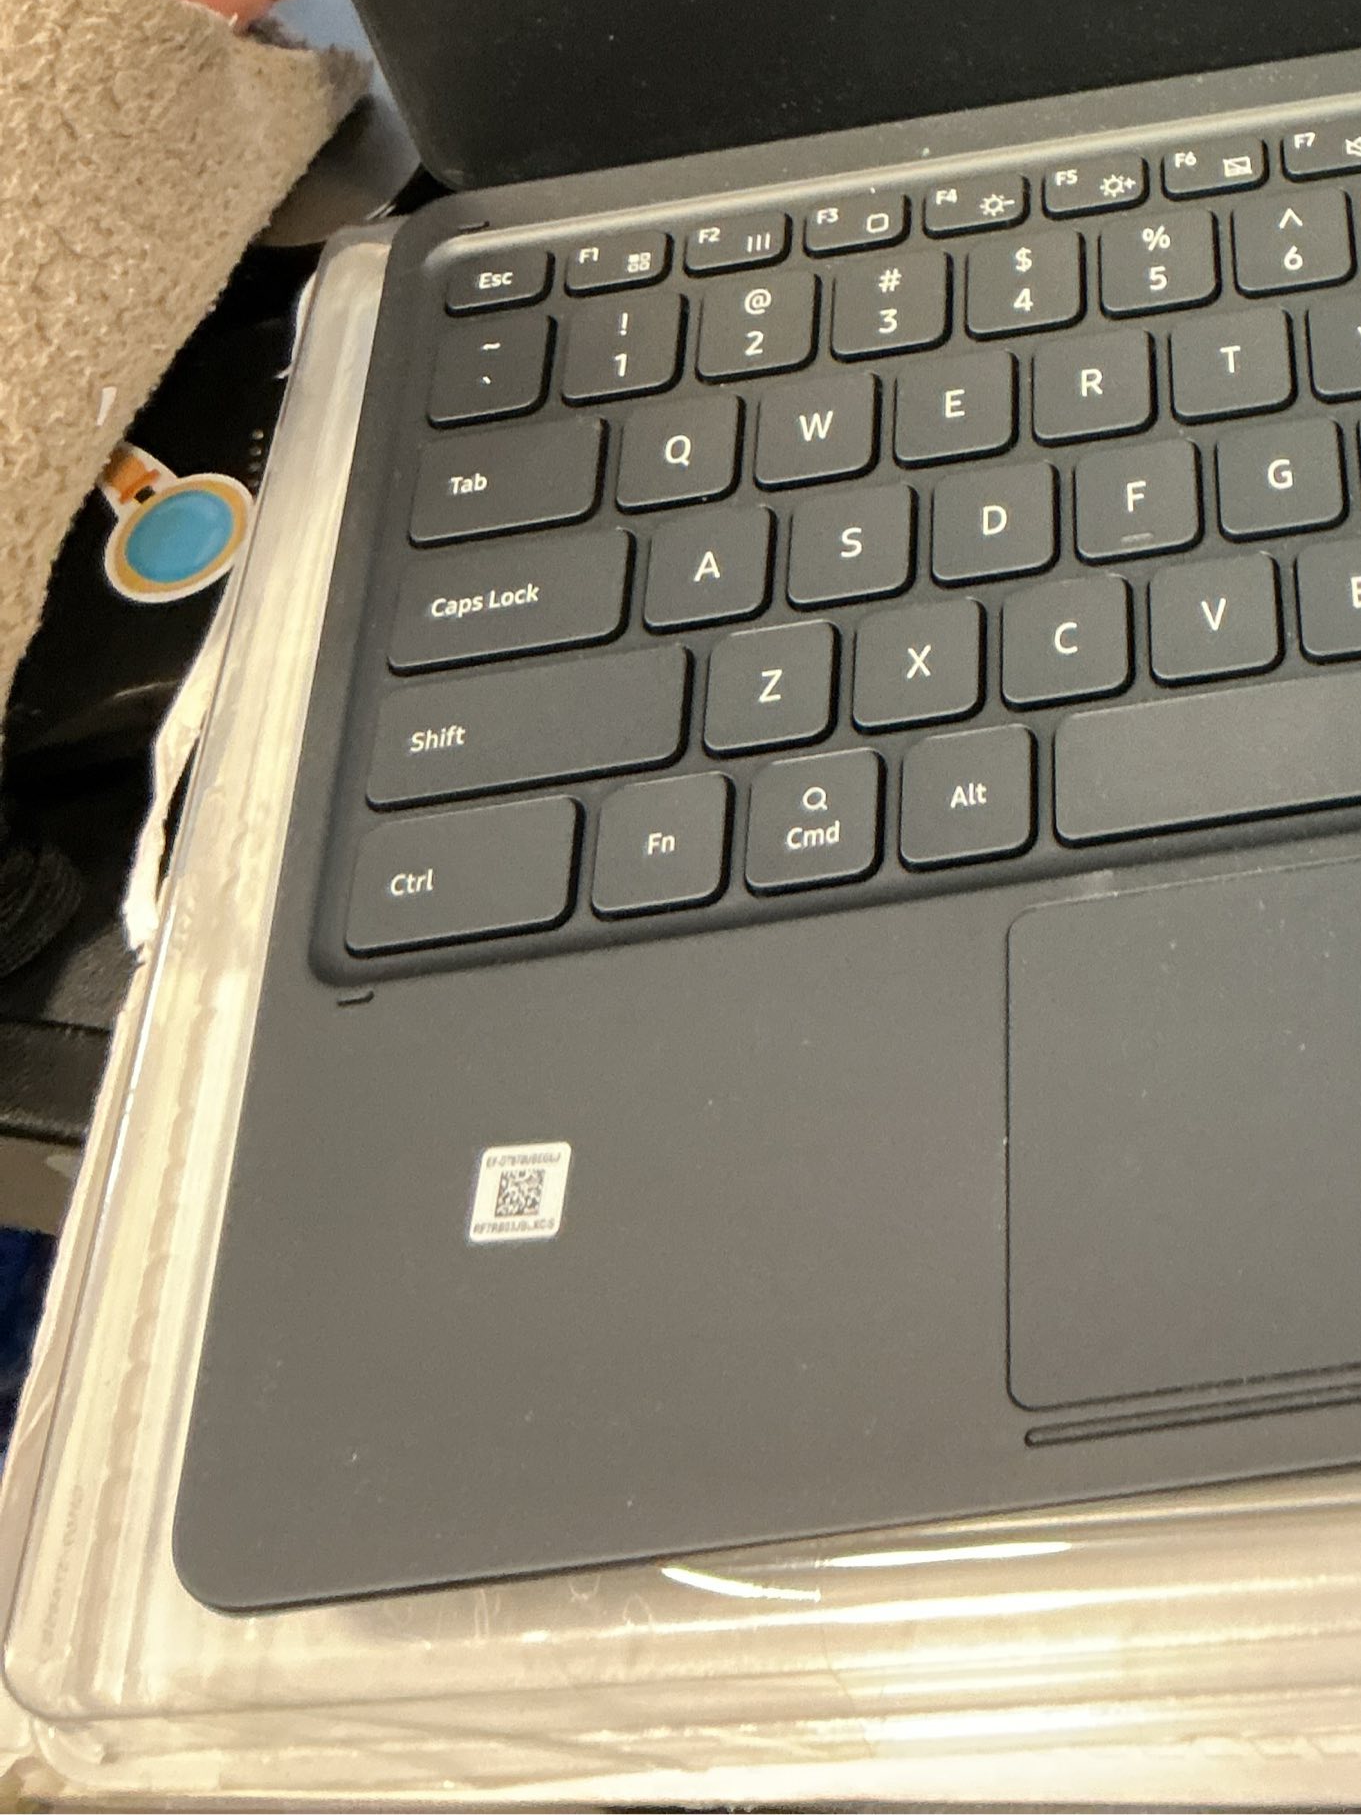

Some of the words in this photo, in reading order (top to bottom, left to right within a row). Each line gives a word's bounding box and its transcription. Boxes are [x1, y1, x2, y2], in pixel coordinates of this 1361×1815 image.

[1293, 131, 1316, 150] F7
[1174, 151, 1197, 169] F6
[1054, 169, 1078, 187] F5
[935, 188, 958, 206] F4
[816, 207, 839, 225] F3
[1278, 208, 1304, 230] ^
[698, 227, 721, 244] F2
[1141, 225, 1171, 252] %
[578, 247, 599, 264] F1
[1014, 246, 1033, 273] $
[1283, 245, 1304, 271] 6
[478, 271, 514, 290] Esc
[878, 268, 902, 293] #
[1148, 265, 1168, 291] 5
[744, 288, 772, 315] @
[1013, 287, 1034, 312] 4
[619, 312, 629, 336] !
[878, 308, 898, 334] 3
[744, 330, 764, 357] 2
[614, 353, 627, 377] 1
[1219, 345, 1241, 374] T
[1080, 368, 1103, 398] R
[944, 388, 966, 419] E
[798, 410, 834, 442] W
[664, 434, 691, 467] Q
[450, 472, 488, 495] Tab
[1267, 458, 1293, 490] G
[1126, 480, 1147, 513] F
[982, 505, 1008, 536] D
[840, 527, 862, 558] S
[693, 551, 721, 582] A
[430, 595, 484, 619] Caps
[487, 582, 540, 610] Lock
[1200, 597, 1227, 631] V
[1054, 621, 1078, 655] C
[906, 644, 932, 679] X
[758, 668, 783, 704] Z
[409, 725, 466, 753] Shift
[950, 782, 987, 809] Alt
[647, 832, 675, 855] Fn
[784, 820, 840, 850] Cmd
[390, 868, 433, 897] Ctrl
